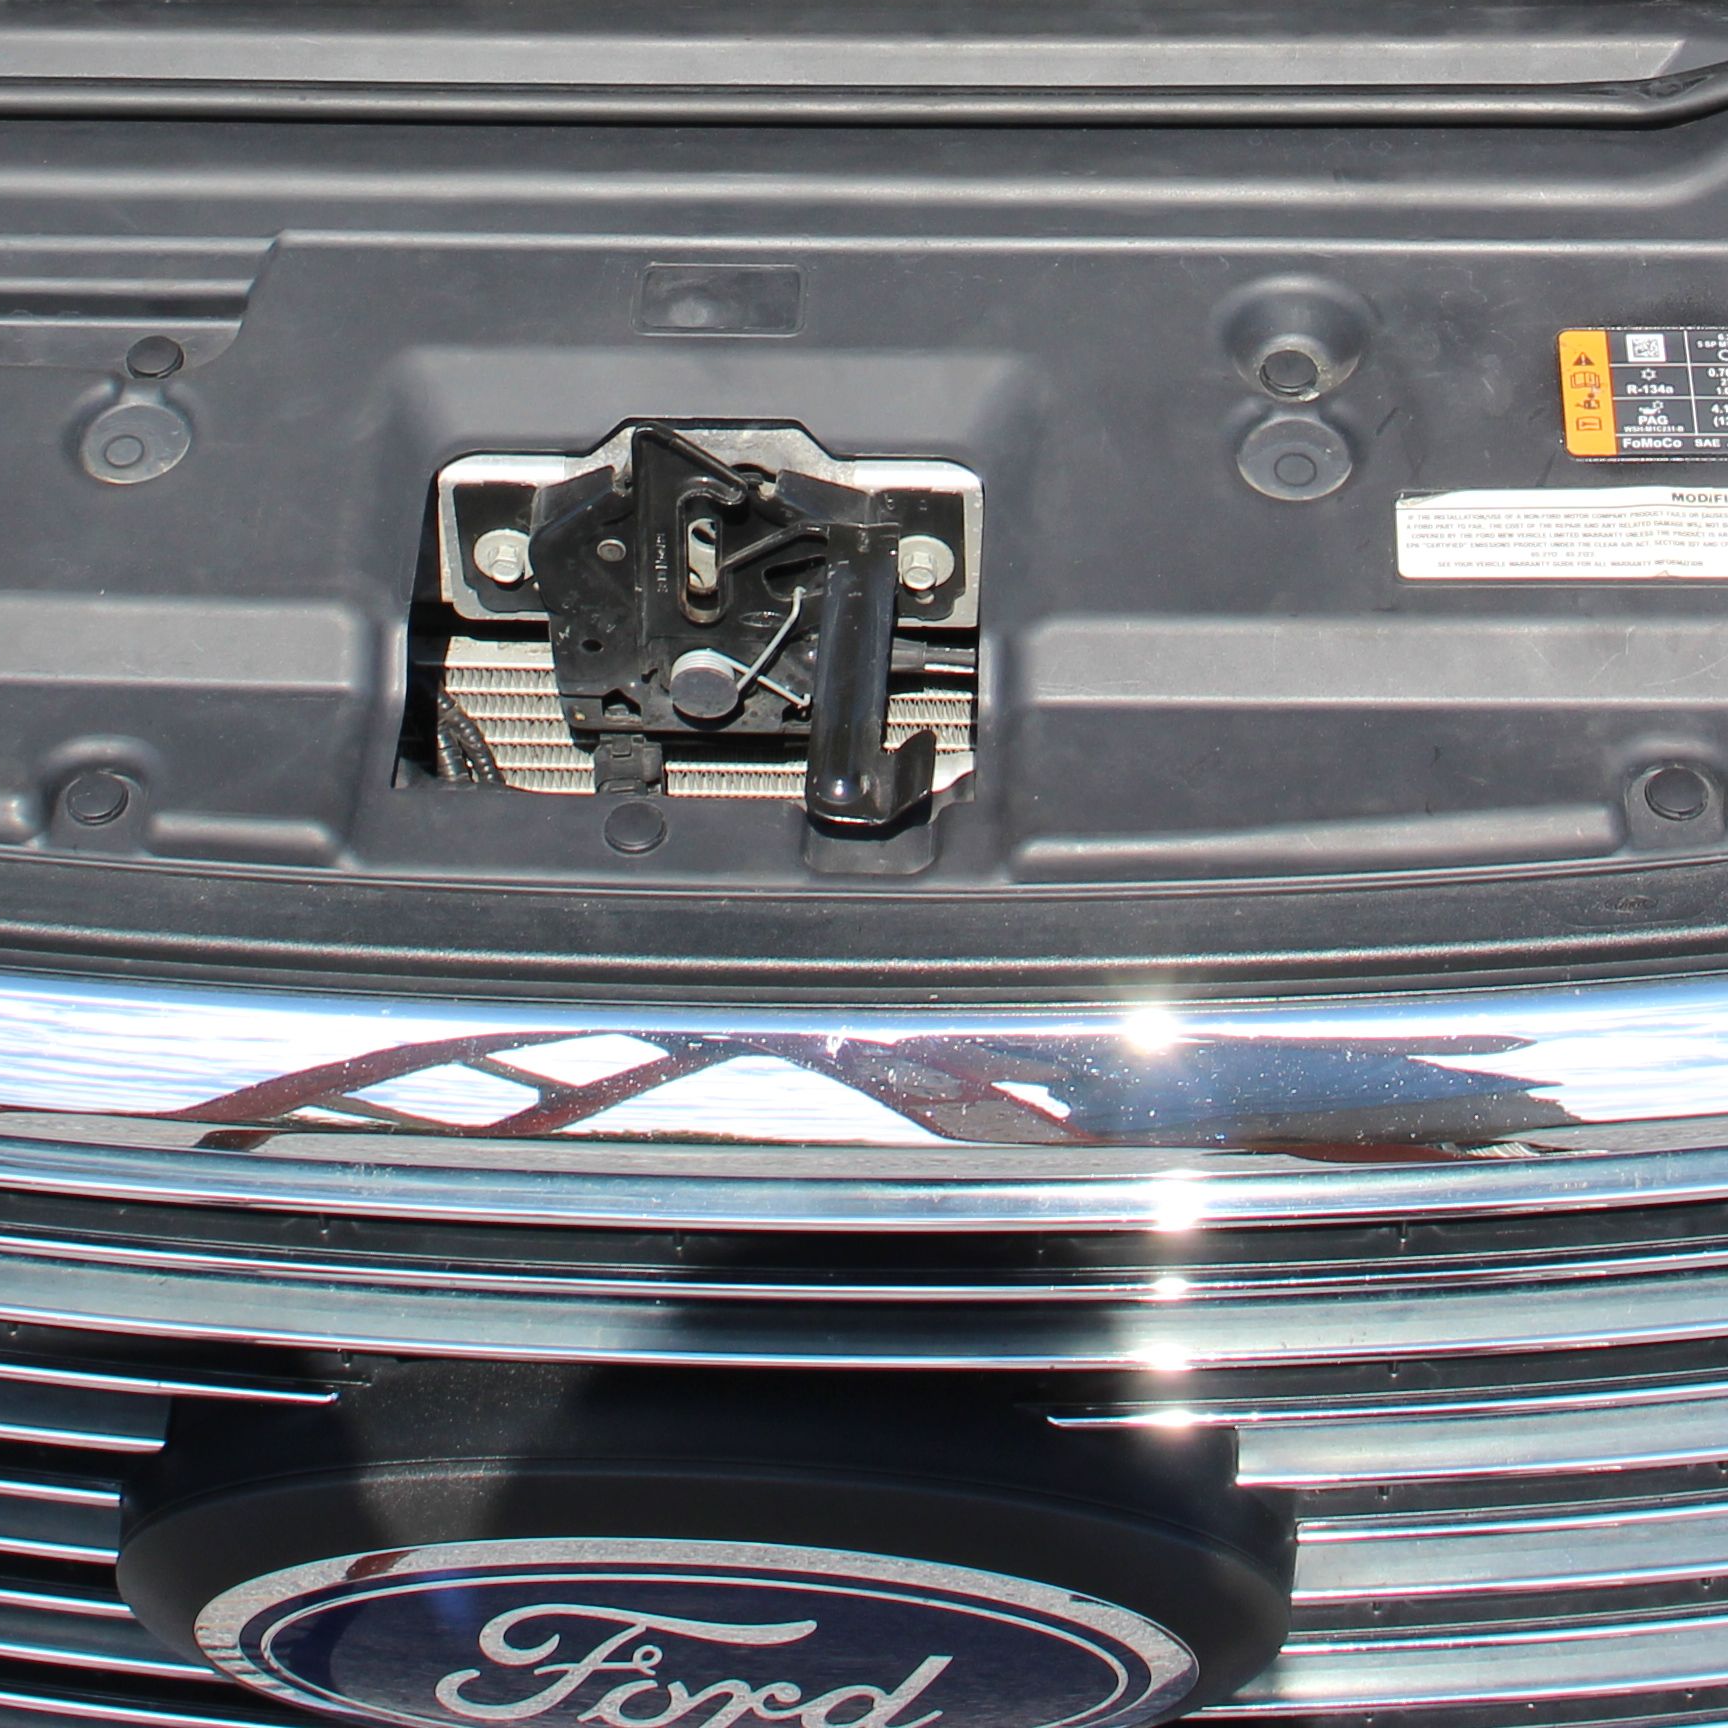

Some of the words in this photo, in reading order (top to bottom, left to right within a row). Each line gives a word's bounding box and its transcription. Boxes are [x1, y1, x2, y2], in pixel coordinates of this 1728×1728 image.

[1704, 340, 1717, 348] SP
[1626, 384, 1674, 395] R-134a
[1711, 404, 1728, 414] 4.1
[1638, 415, 1669, 425] PAG
[1622, 437, 1683, 449] FoMoCo
[1694, 438, 1721, 448] SAE
[434, 1602, 954, 1728] Ford
